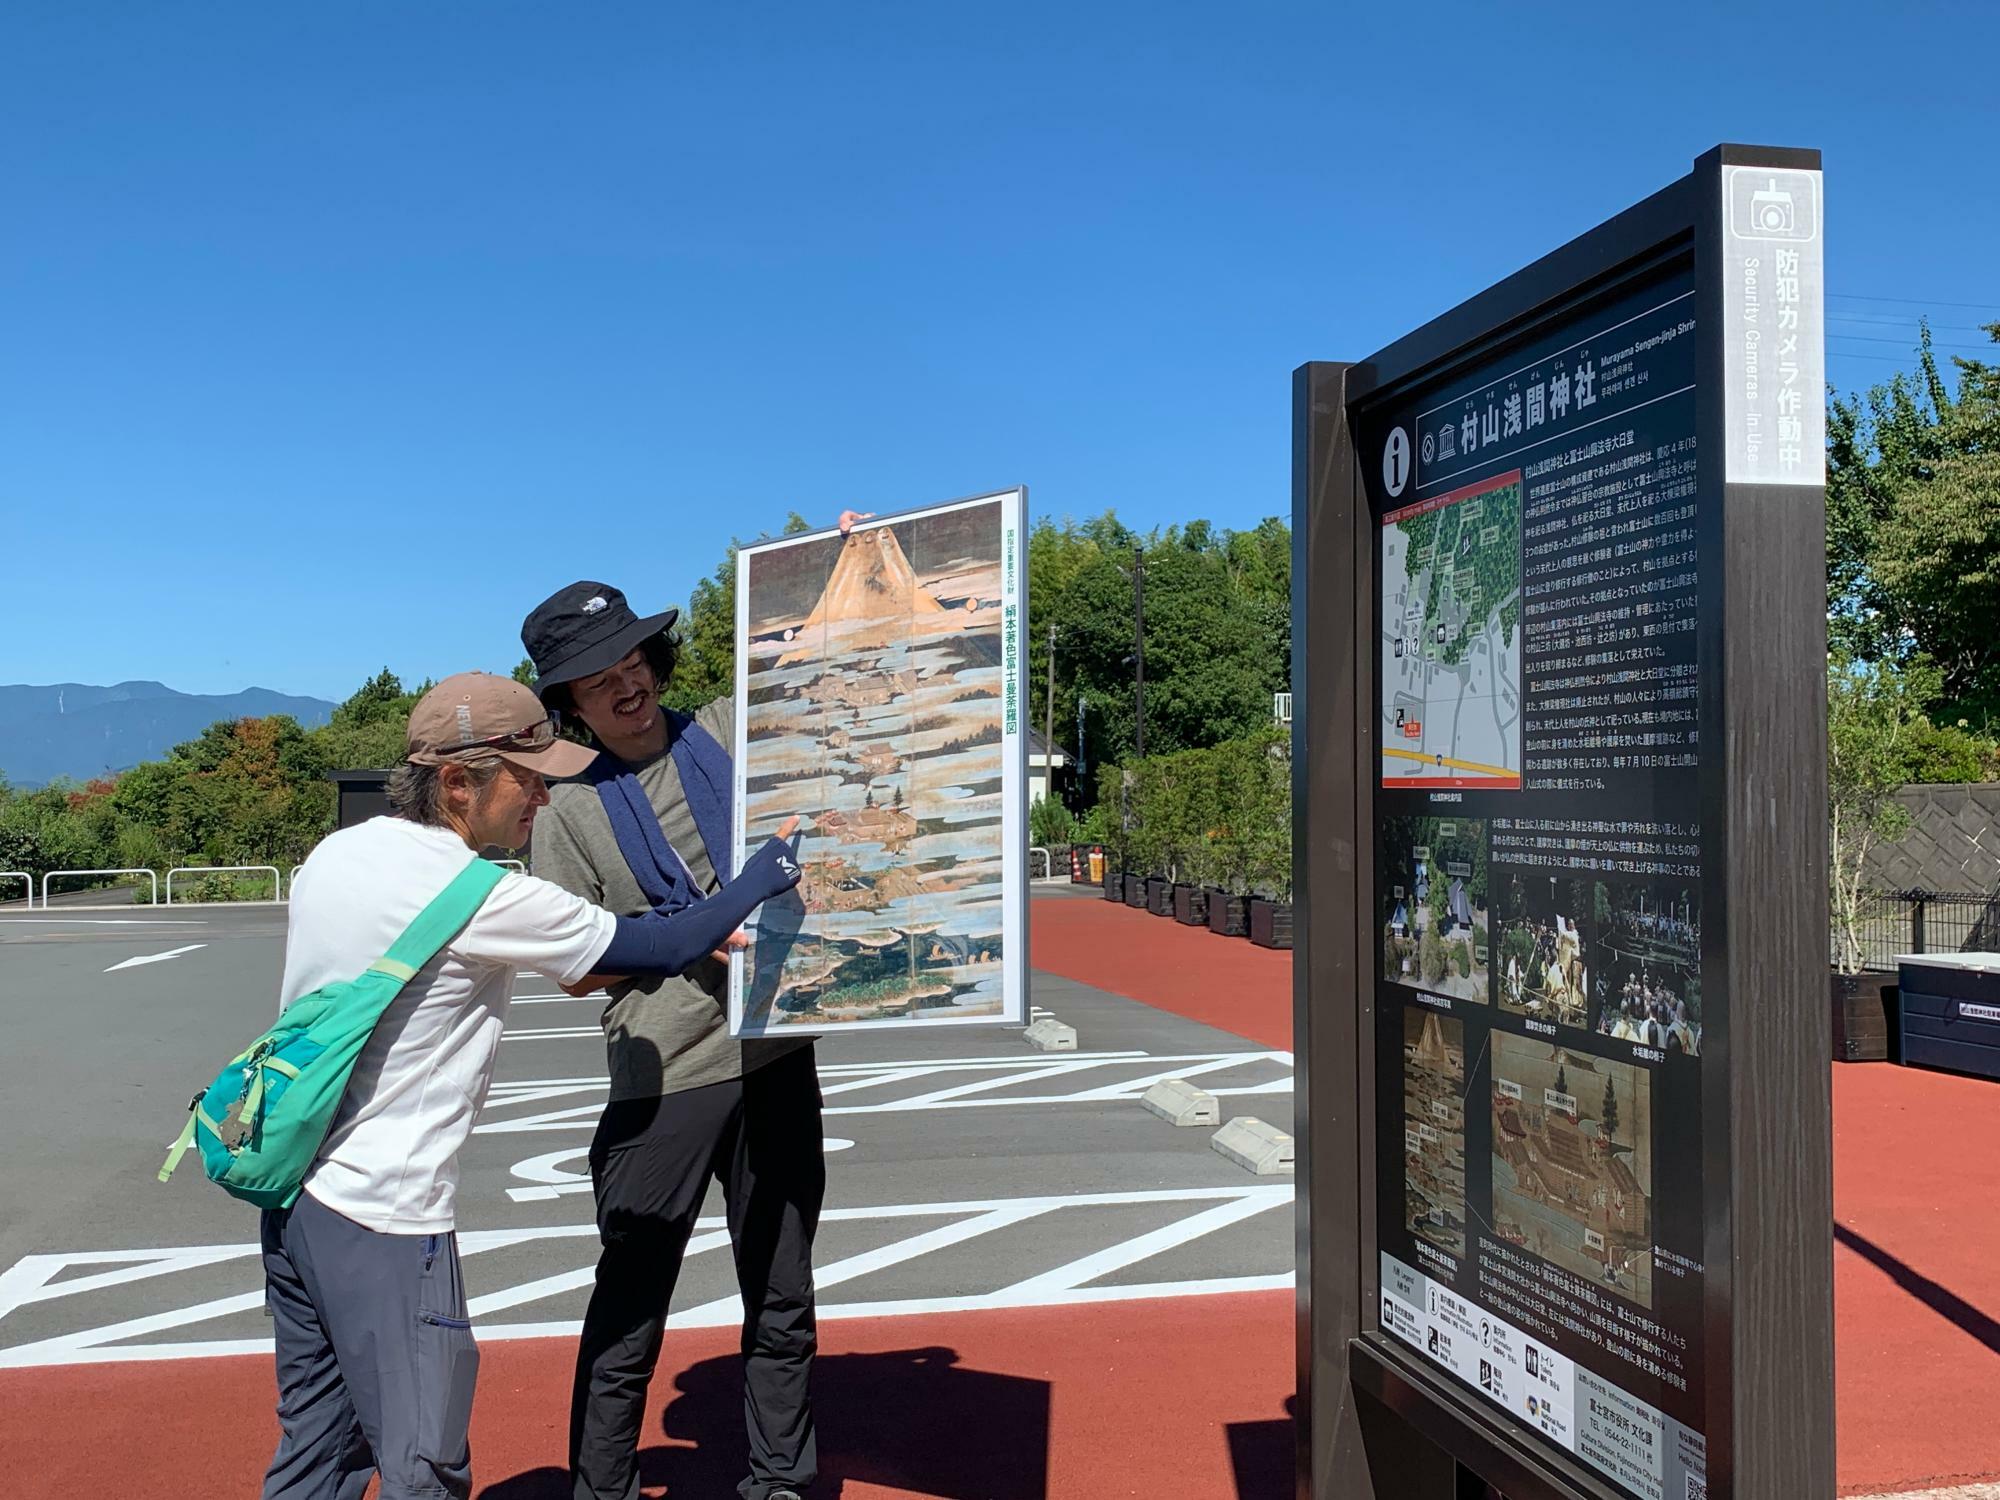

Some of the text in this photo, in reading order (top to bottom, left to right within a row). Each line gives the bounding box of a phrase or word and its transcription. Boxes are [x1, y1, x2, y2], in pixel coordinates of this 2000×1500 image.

[1601, 346, 1634, 367] Murayama
[1635, 327, 1676, 353] Sengen-jinja
[1745, 257, 1761, 463] Security Cameras In Use
[1775, 249, 1802, 470] 防犯カメラ作動中
[1461, 355, 1597, 457] 村山浅間神社
[1005, 603, 1017, 735] 絹本著色富士曼荼羅図
[1580, 1428, 1596, 1446] Culture
[1617, 1452, 1641, 1478] Fujinomiya
[1642, 1468, 1652, 1485] City
[1589, 1395, 1629, 1434] 富士宮市役所
[1631, 1421, 1653, 1448] 文化課
[1604, 1424, 1645, 1461] 0544-22-1111
